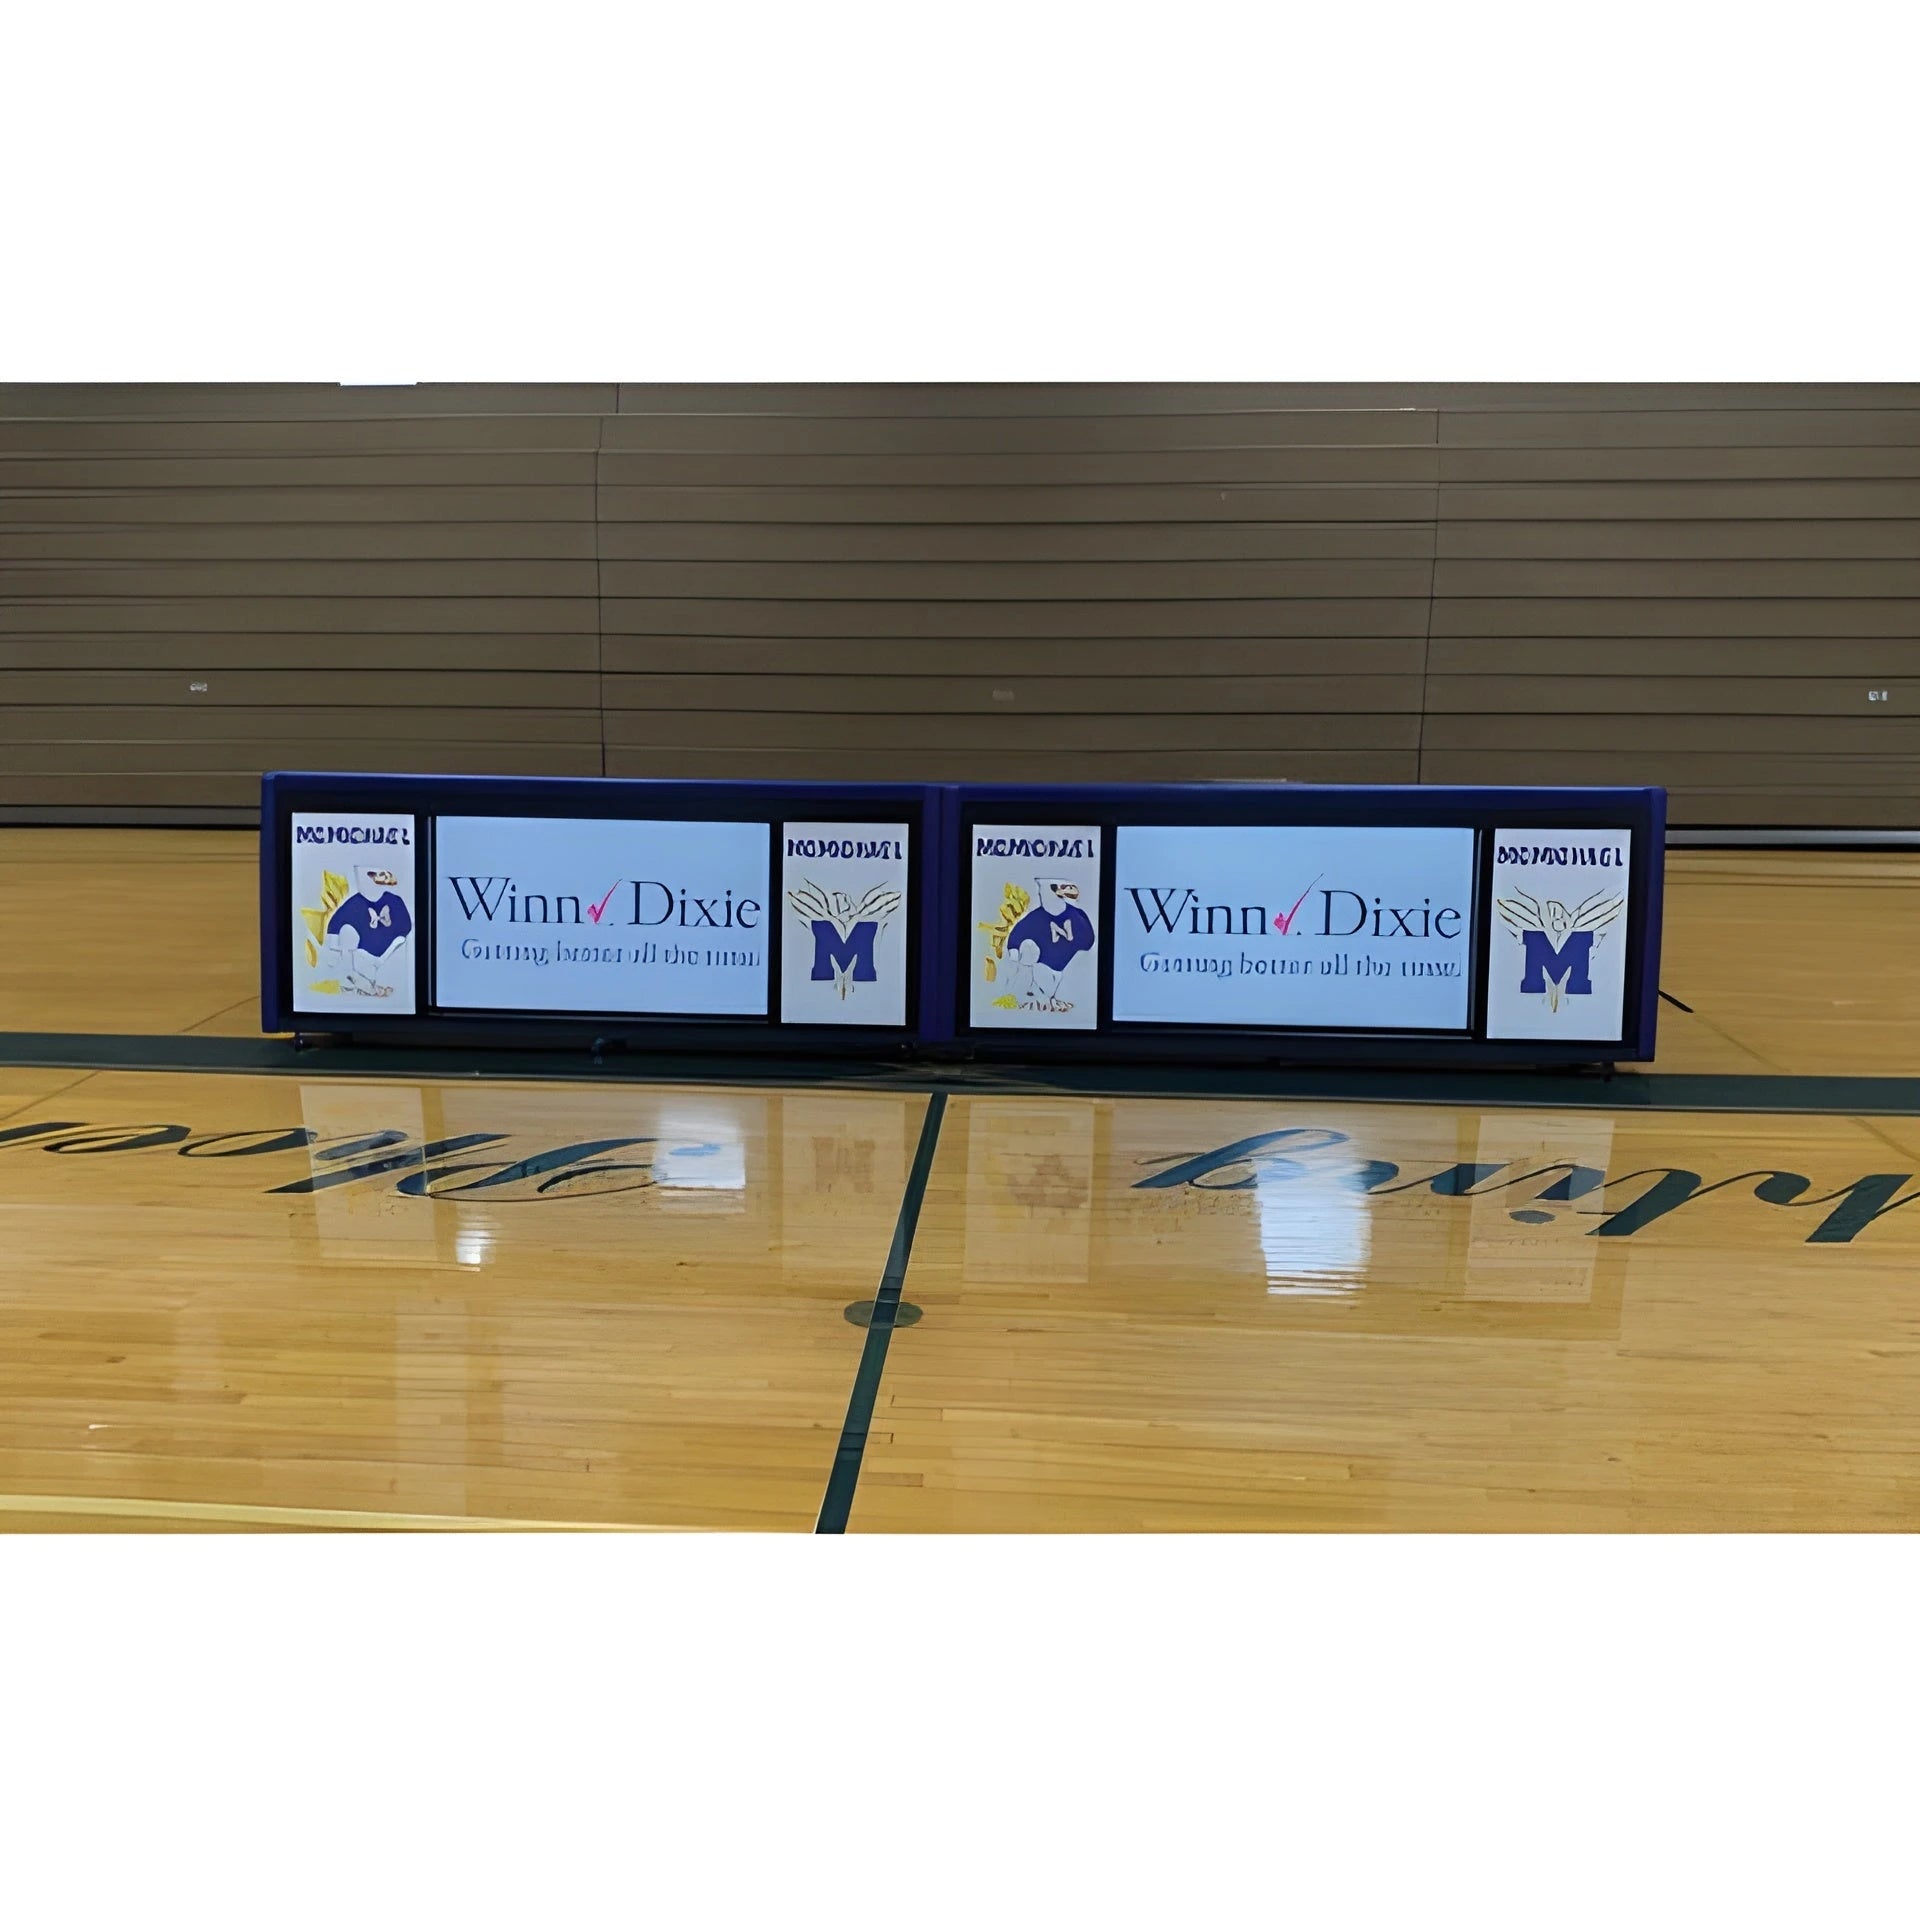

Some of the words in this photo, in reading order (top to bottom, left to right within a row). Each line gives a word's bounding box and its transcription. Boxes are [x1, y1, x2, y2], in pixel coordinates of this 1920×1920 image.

[447, 876, 584, 924] Winn
[626, 880, 761, 929] Dixie
[1123, 887, 1267, 935] Winn
[1314, 890, 1461, 939] Dixie
